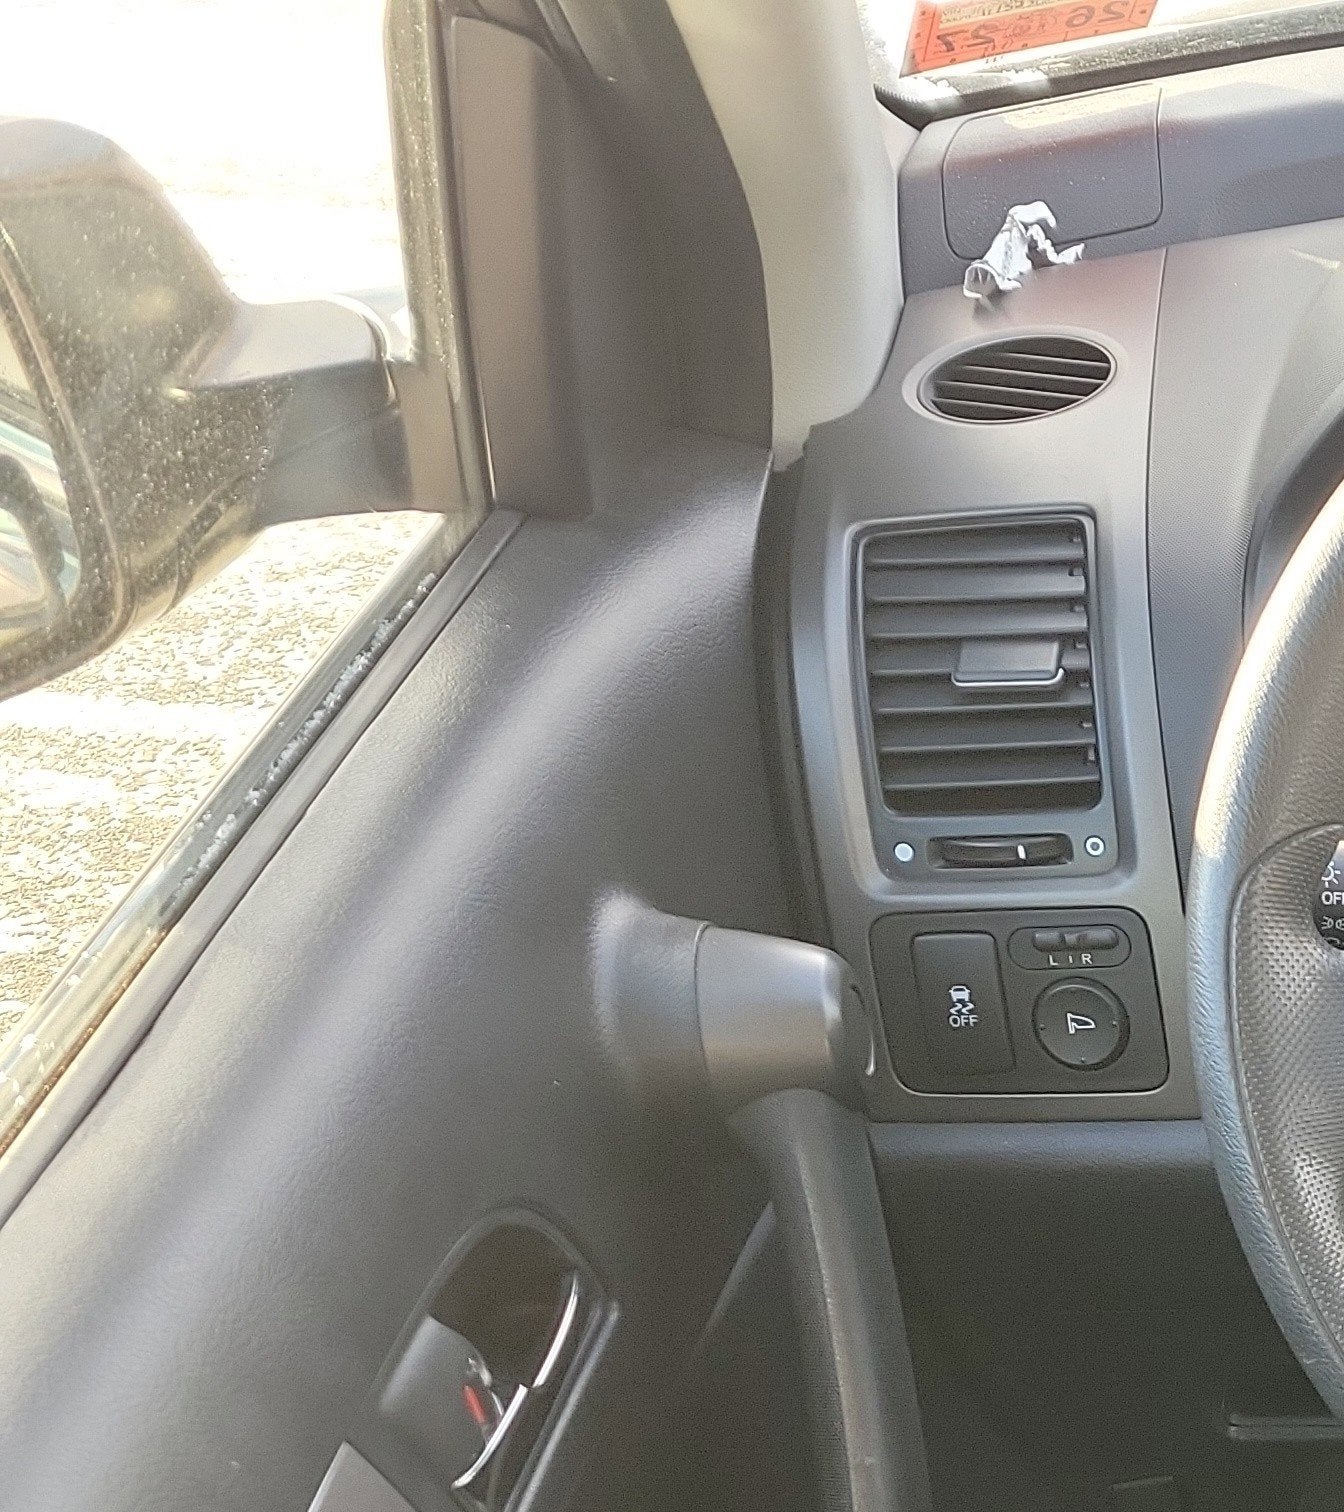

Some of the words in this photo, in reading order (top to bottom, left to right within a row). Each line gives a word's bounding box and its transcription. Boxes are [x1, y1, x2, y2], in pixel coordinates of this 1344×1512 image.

[1049, 954, 1059, 966] L
[1082, 953, 1093, 965] R
[949, 1014, 978, 1028] OFF
